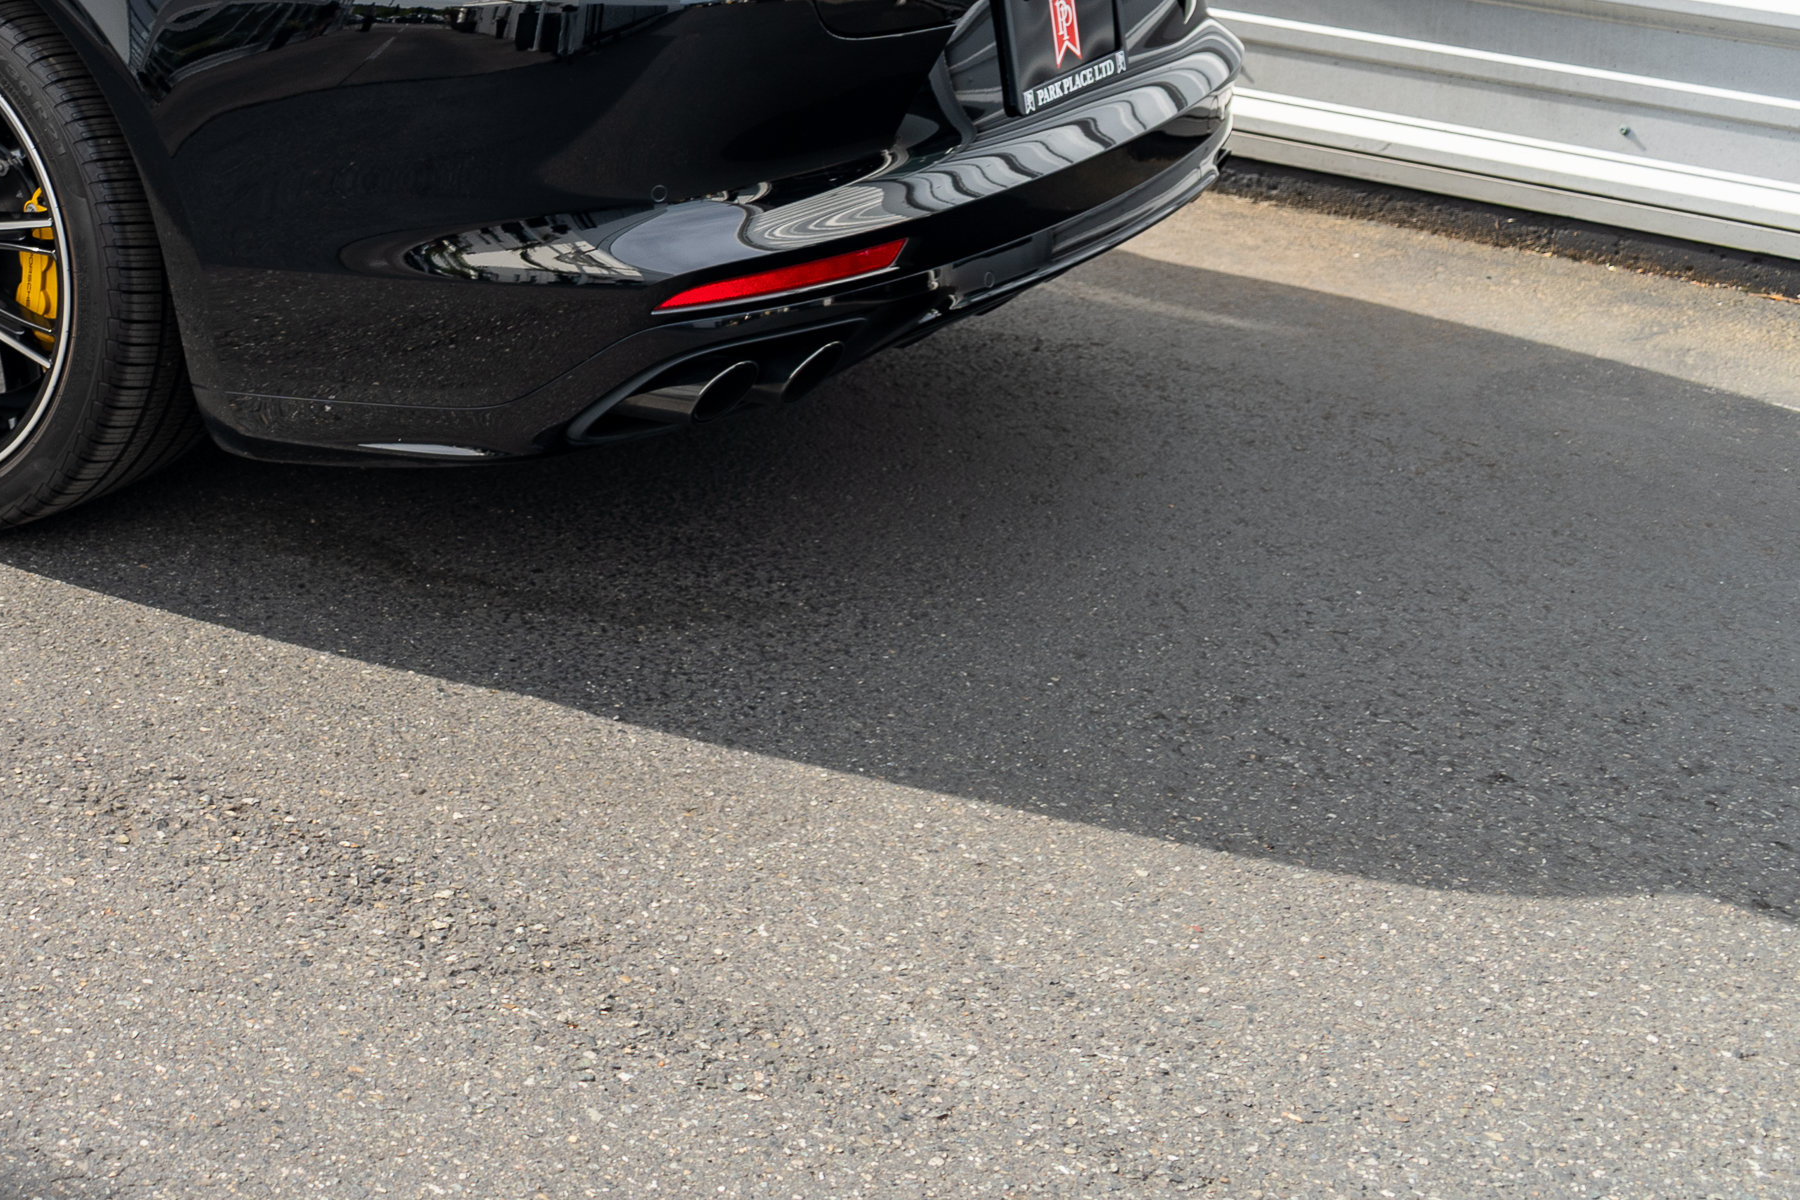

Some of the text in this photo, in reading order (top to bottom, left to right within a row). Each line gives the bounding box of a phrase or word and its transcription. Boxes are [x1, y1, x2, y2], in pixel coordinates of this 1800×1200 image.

[1036, 80, 1064, 106] PARK
[1063, 68, 1095, 95] PLACE
[1093, 59, 1115, 82] LTD
[25, 252, 34, 308] ORSCHE
